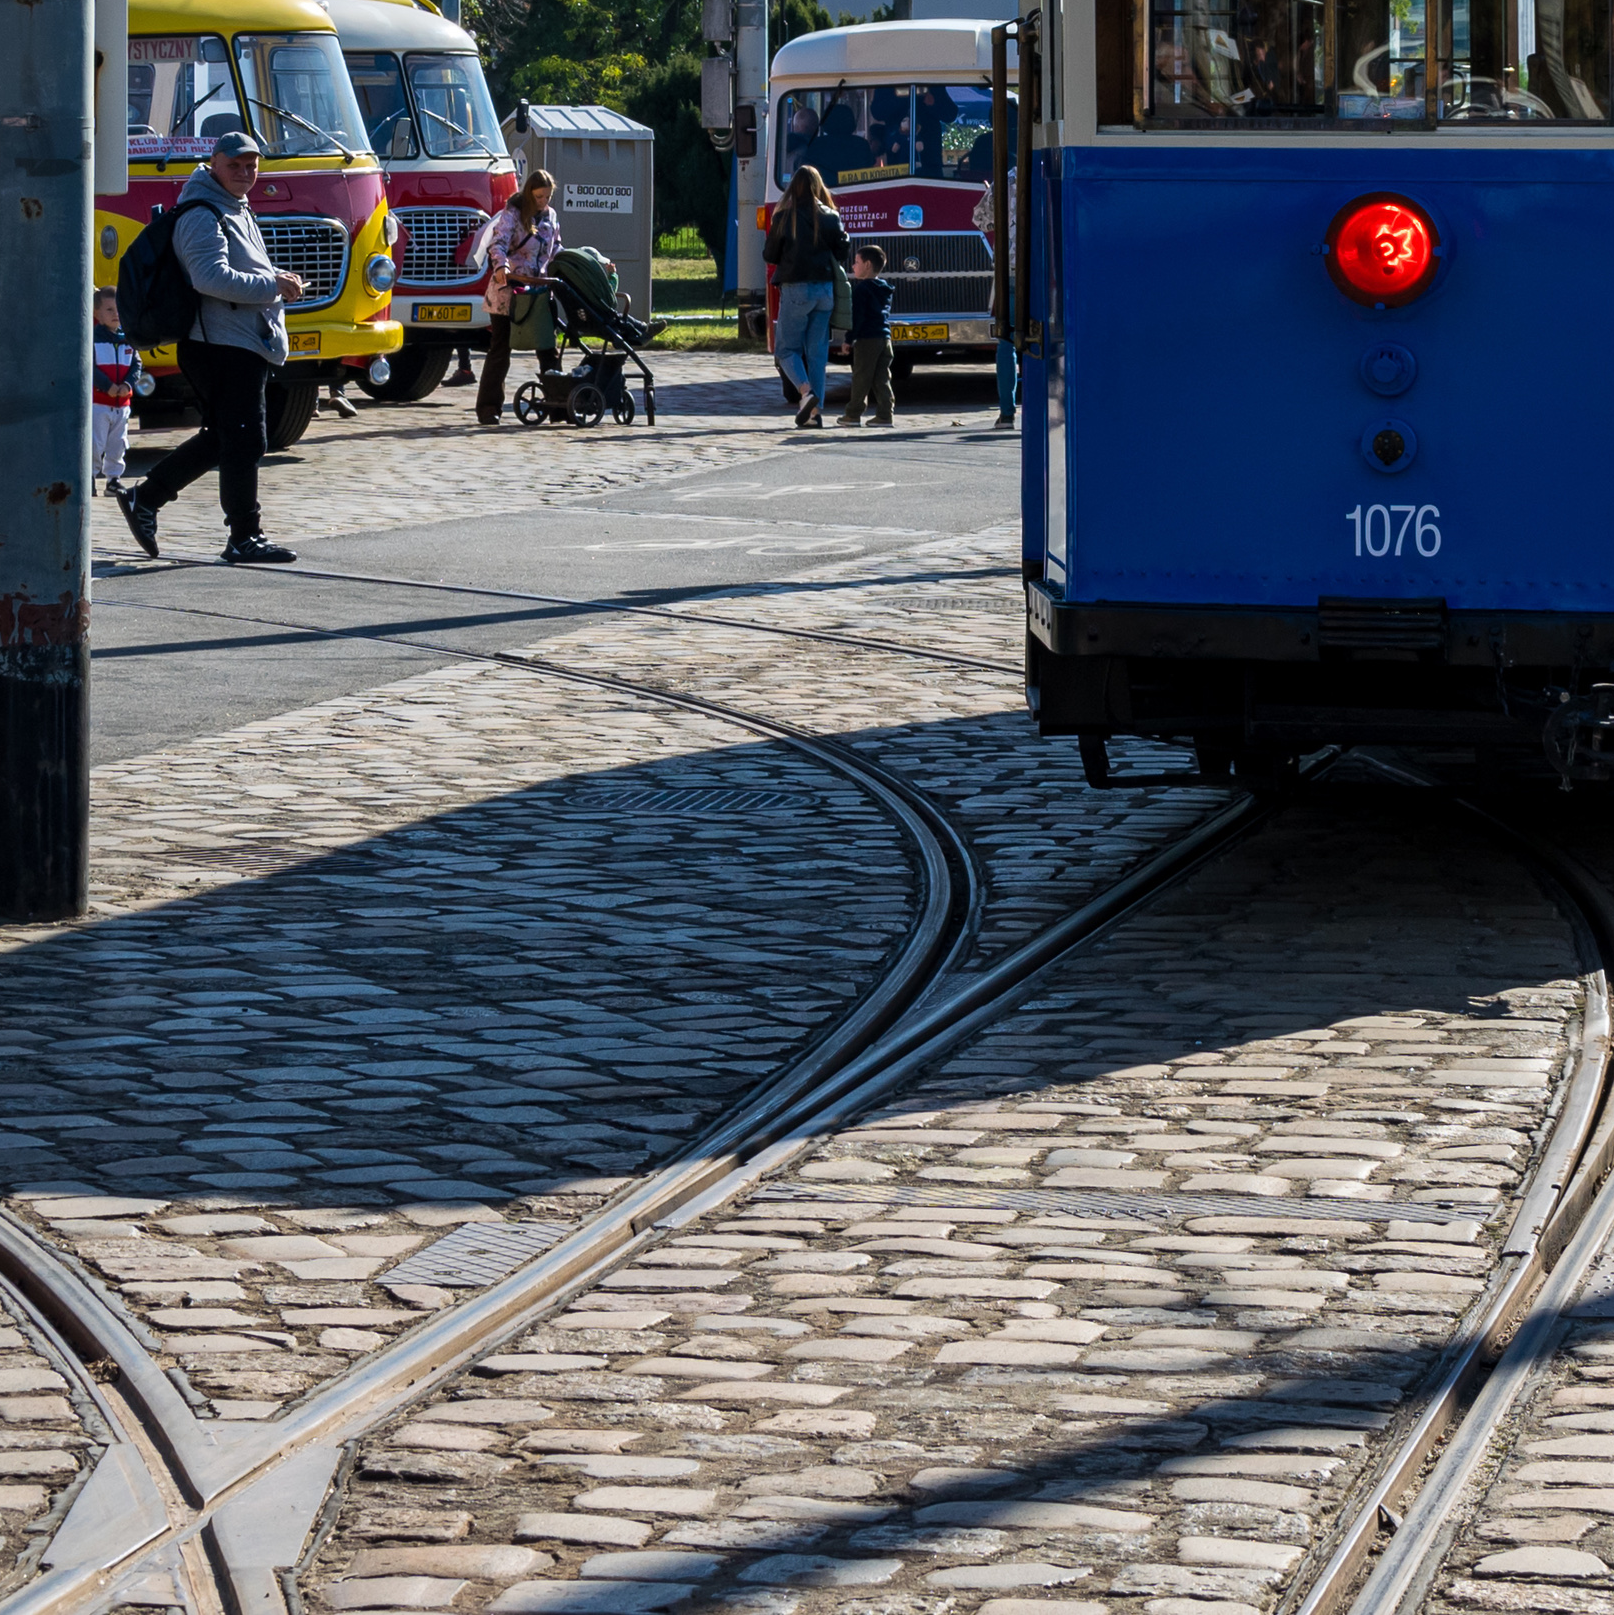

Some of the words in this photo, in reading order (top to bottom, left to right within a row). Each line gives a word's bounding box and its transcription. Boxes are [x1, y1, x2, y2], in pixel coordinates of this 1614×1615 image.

[128, 40, 193, 60] YSTYCZNY
[130, 138, 157, 146] KLUB
[162, 137, 219, 146] SYMPATYK
[128, 145, 187, 155] RANSPORTU
[191, 145, 215, 154] MIEJ
[577, 186, 594, 195] 800
[596, 186, 613, 196] 000
[615, 187, 632, 197] 800
[576, 199, 619, 211] mtoilet.pl
[839, 205, 868, 213] MUZEUM
[839, 213, 887, 221] MOTORYZACJI
[420, 306, 434, 320] DW
[436, 306, 456, 320] 60T
[912, 326, 929, 339] S5
[1346, 504, 1442, 557] 1076
